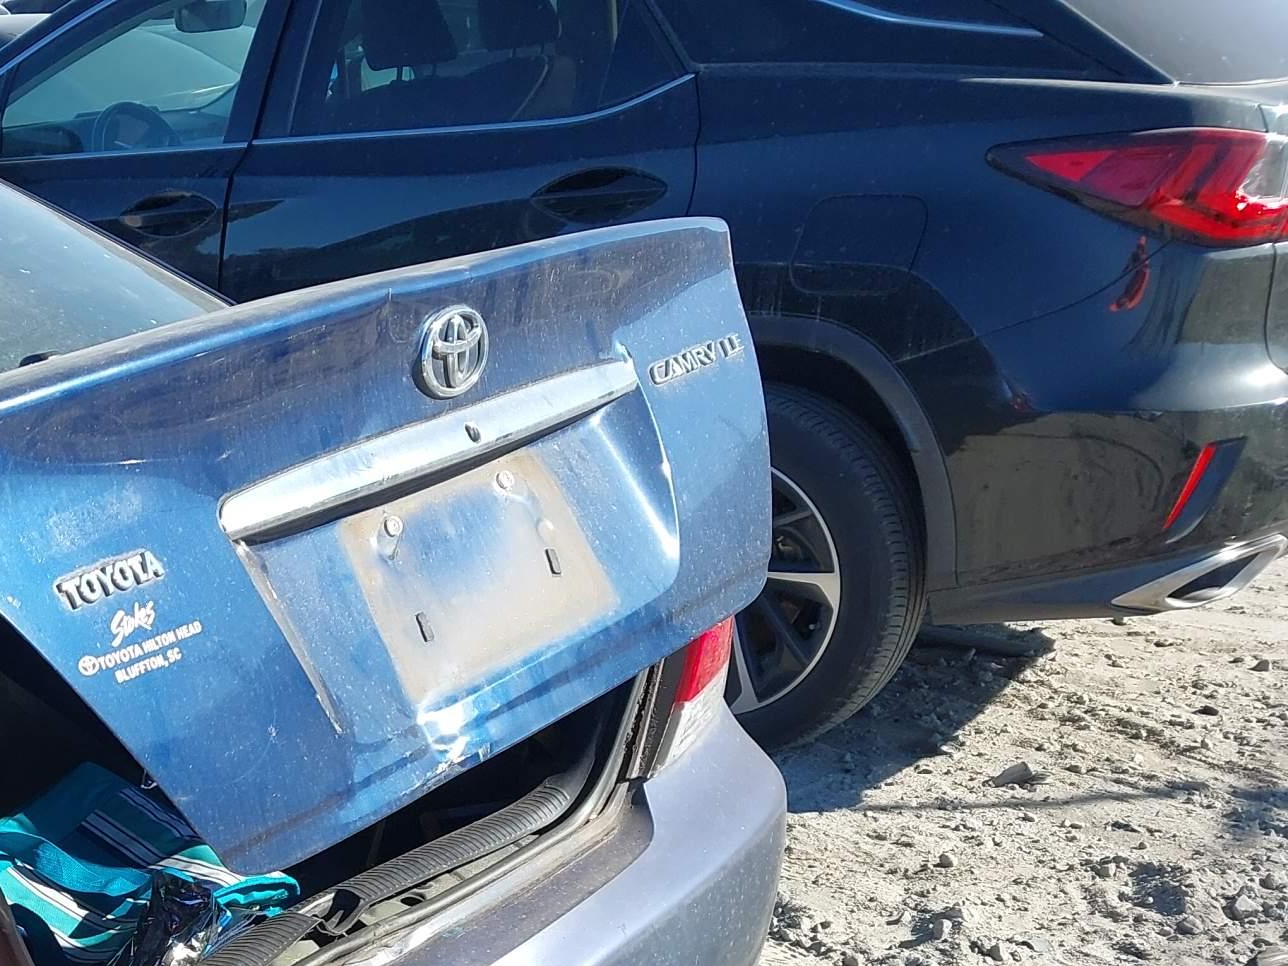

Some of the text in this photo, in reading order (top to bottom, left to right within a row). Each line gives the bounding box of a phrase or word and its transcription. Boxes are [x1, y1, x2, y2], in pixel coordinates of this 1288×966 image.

[649, 341, 717, 386] CAMRY
[55, 549, 165, 611] TOYOTA
[98, 620, 203, 670] TOYOTA HILTON HEAD
[114, 647, 183, 684] BLUFFTON, SC
